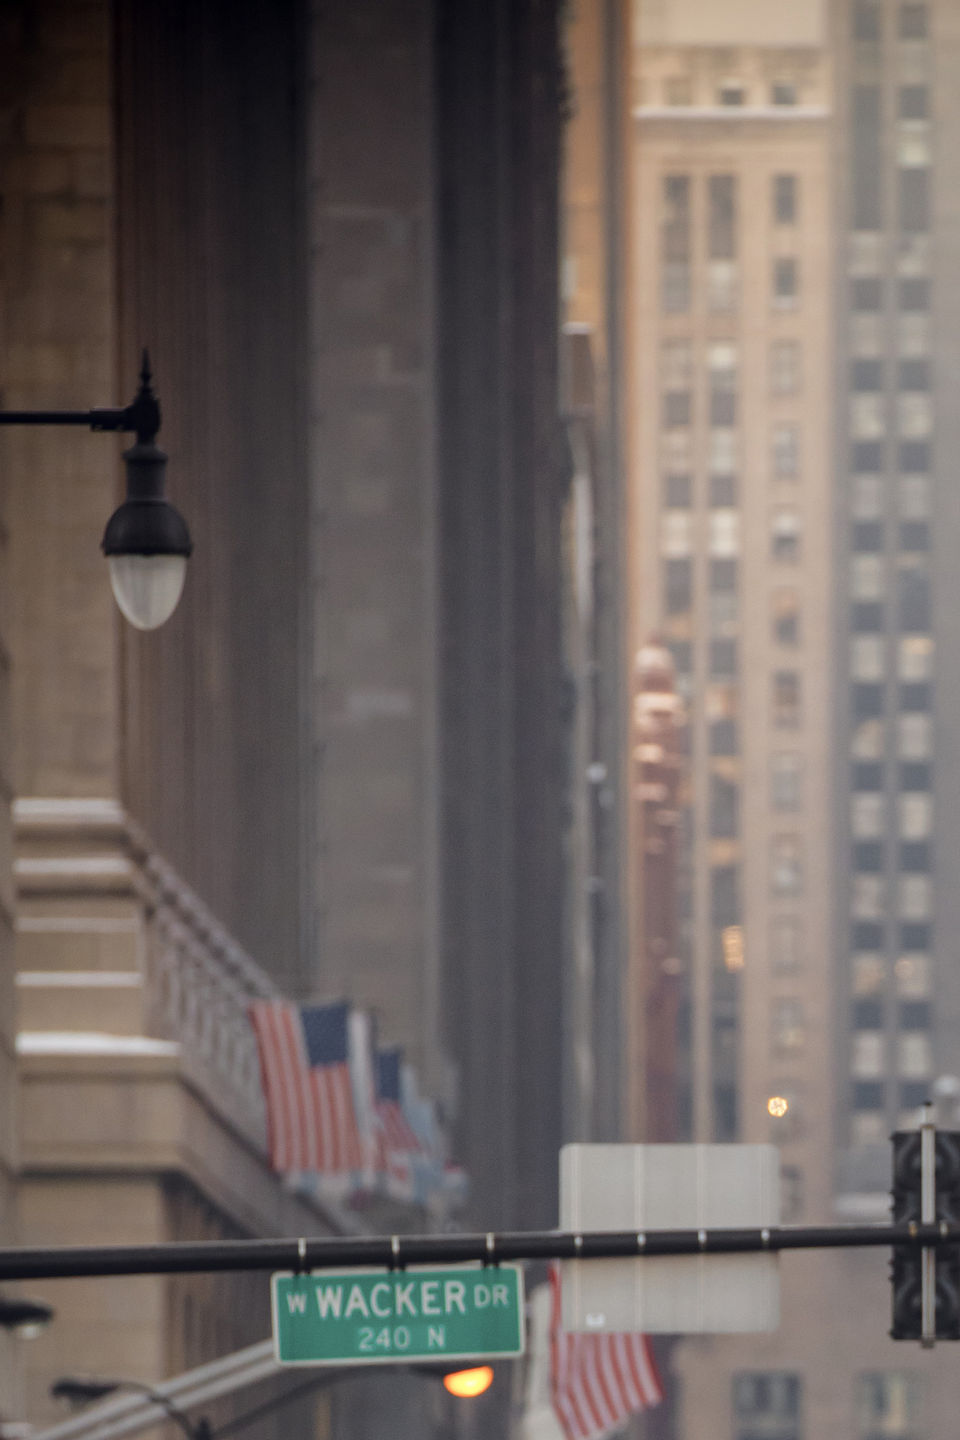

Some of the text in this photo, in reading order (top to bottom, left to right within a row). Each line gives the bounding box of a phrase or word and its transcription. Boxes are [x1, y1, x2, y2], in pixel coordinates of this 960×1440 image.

[286, 1280, 509, 1319] W WACKER DR
[358, 1326, 445, 1350] 240 N
